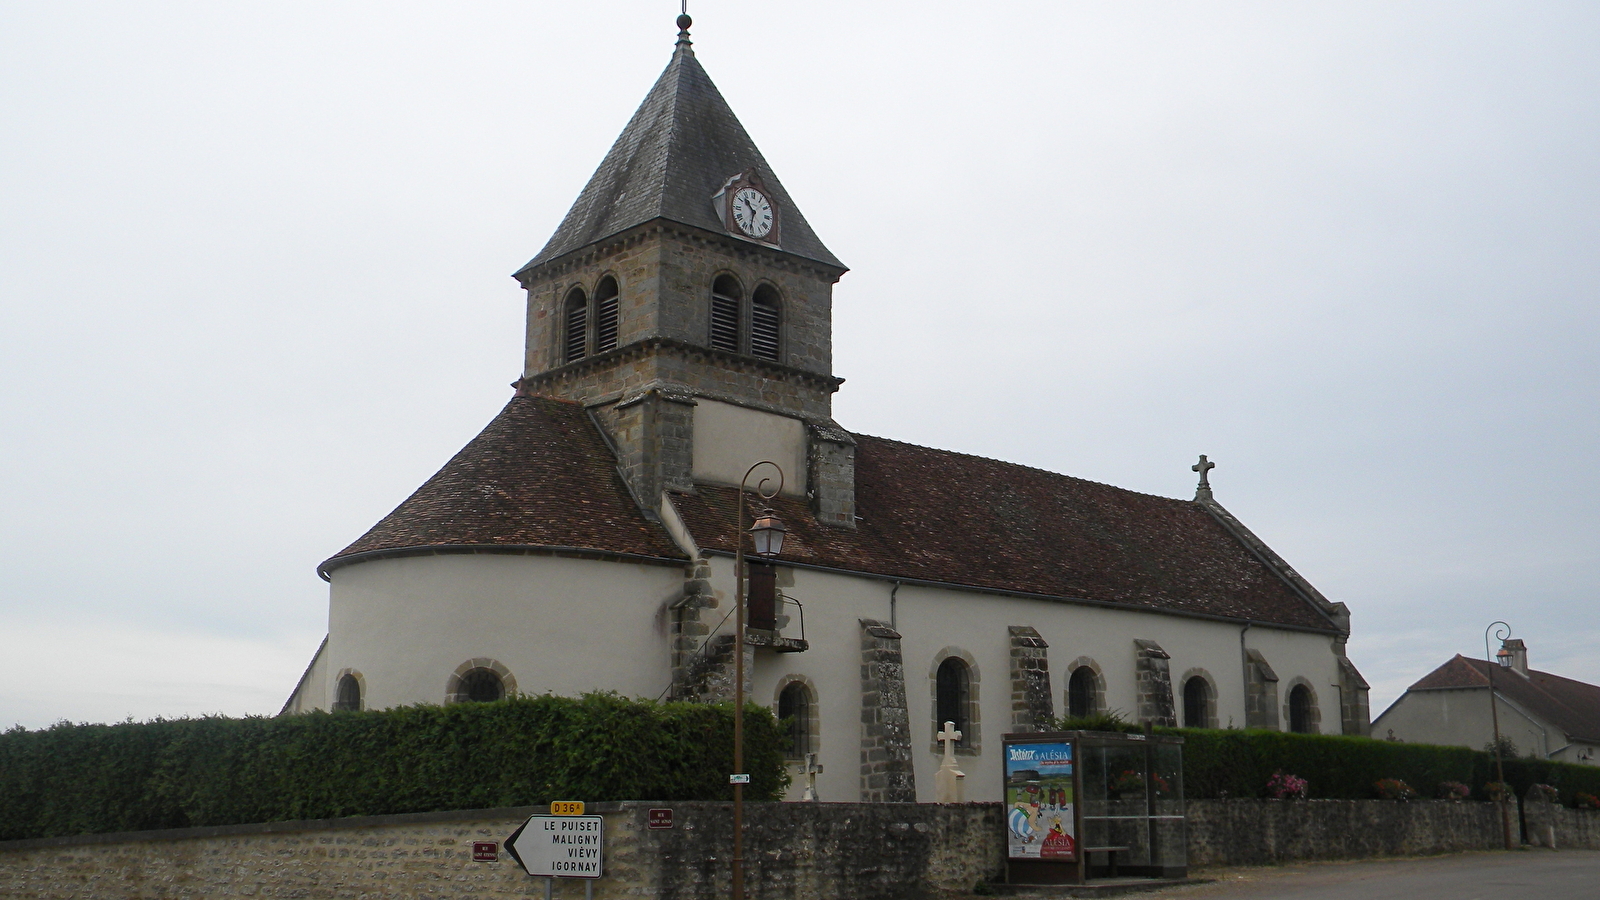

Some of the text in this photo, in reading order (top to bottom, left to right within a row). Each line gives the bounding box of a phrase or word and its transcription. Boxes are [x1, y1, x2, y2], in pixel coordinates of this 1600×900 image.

[1040, 749, 1069, 761] ALÉSIA
[554, 803, 560, 813] D
[544, 821, 599, 831] LE PUISET
[552, 834, 598, 845] MALIGNY
[1044, 837, 1070, 847] ALÉSIA
[552, 861, 598, 872] IGORNAY
